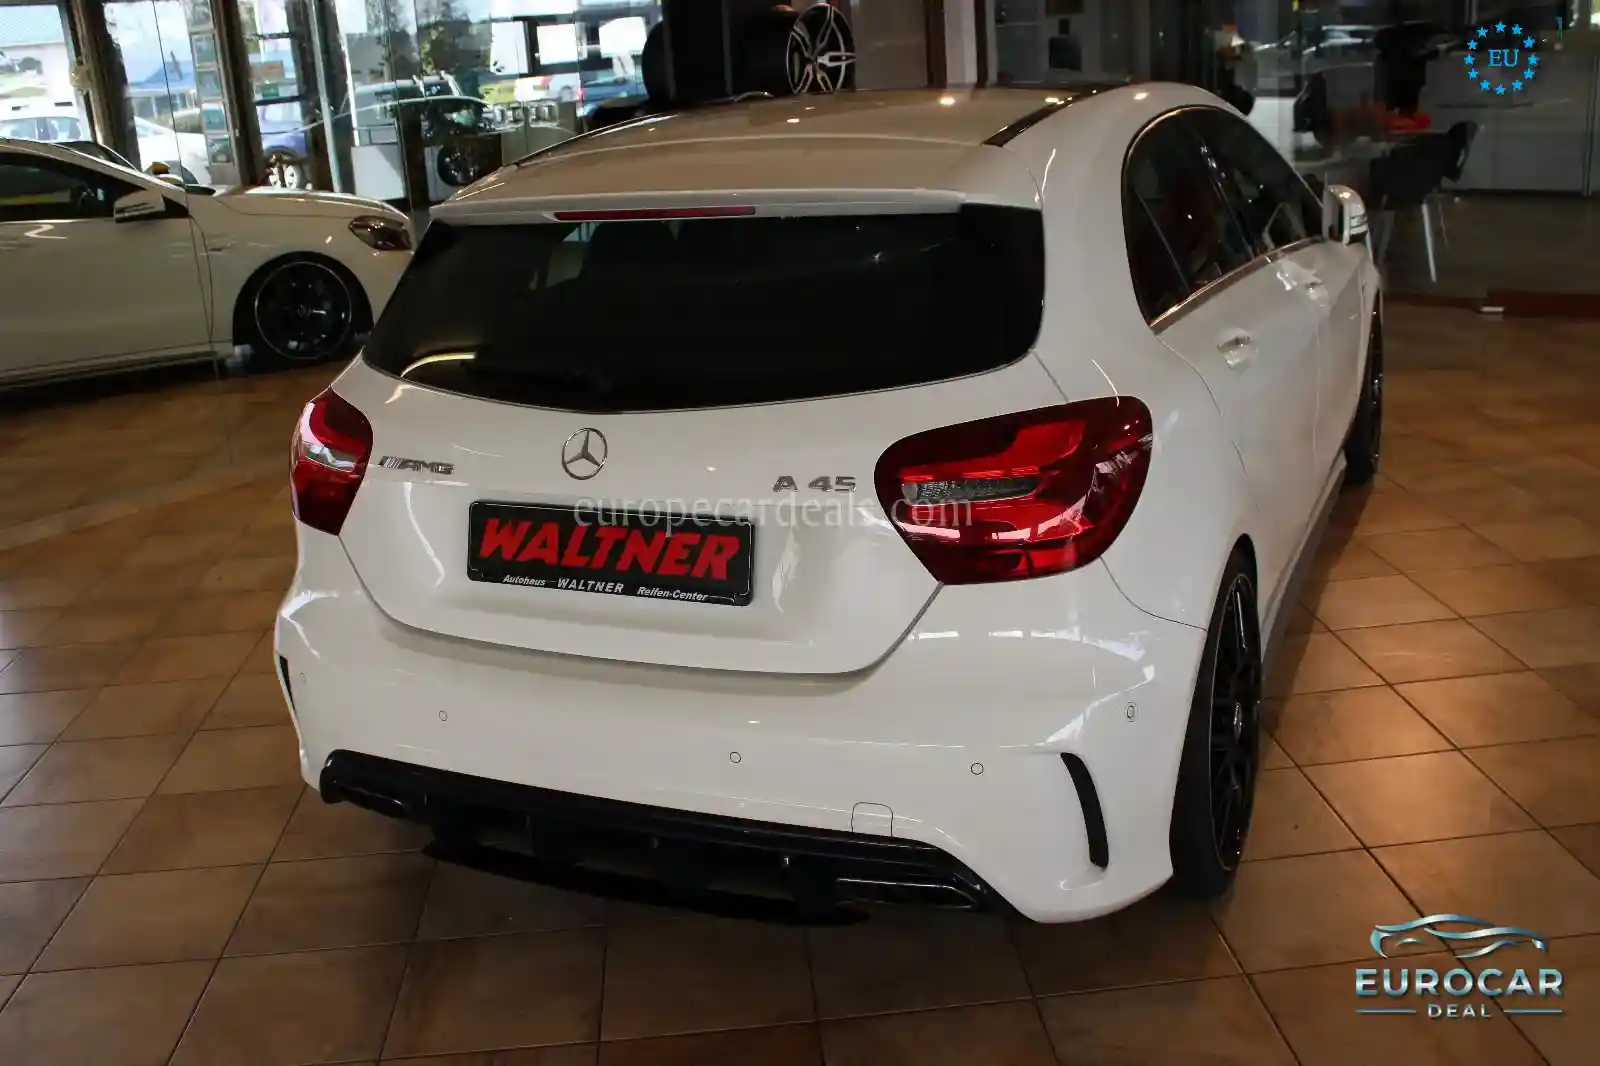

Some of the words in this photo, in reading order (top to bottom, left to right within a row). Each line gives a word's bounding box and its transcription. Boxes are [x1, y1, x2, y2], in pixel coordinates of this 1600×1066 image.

[772, 475, 800, 493] A
[808, 476, 857, 492] 45
[479, 518, 740, 580] WALTNER
[502, 574, 546, 586] Autohaus
[557, 577, 624, 593] WALTNER
[637, 586, 709, 601] Reifen-Center
